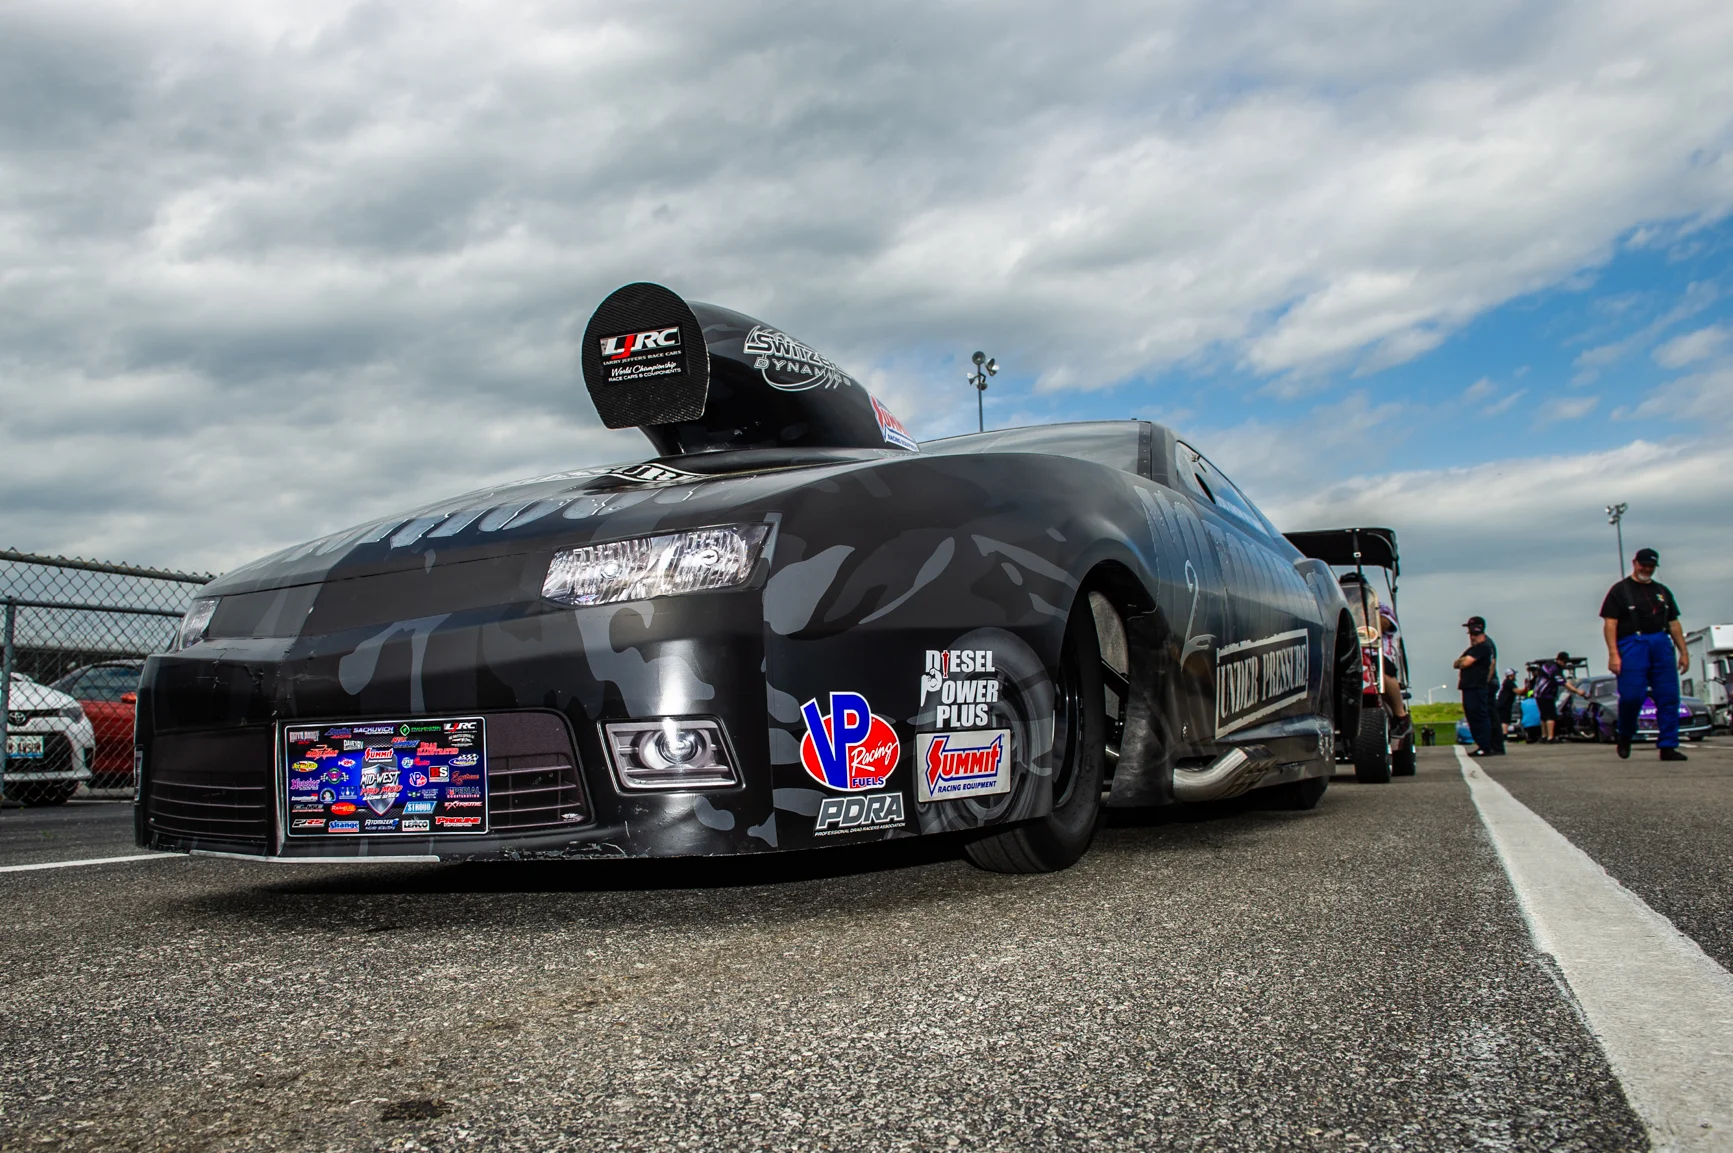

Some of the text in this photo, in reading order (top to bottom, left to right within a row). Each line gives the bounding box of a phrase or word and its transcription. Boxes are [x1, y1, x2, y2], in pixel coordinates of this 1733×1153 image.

[605, 327, 679, 360] LJRC
[622, 355, 647, 363] JEFFERS
[611, 361, 677, 377] World Championship
[643, 368, 682, 378] COMPONENTS
[1220, 643, 1307, 718] UNDER PRESSURE
[936, 703, 989, 728] PLUS
[800, 691, 872, 790] VP
[365, 748, 394, 762] SUMMIT
[851, 740, 898, 776] Racing
[926, 734, 1002, 794] SUMMIT
[361, 771, 401, 785] MID-WEST
[430, 766, 448, 777] BS
[852, 776, 884, 787] FUELS
[938, 780, 997, 793] RACING EQUIPMENT
[408, 803, 431, 811] STROUD
[444, 801, 483, 811] EXTREME
[815, 792, 905, 830] PDRA
[814, 829, 849, 837] PROFESSIONAL
[880, 822, 906, 830] ASSOCIATION
